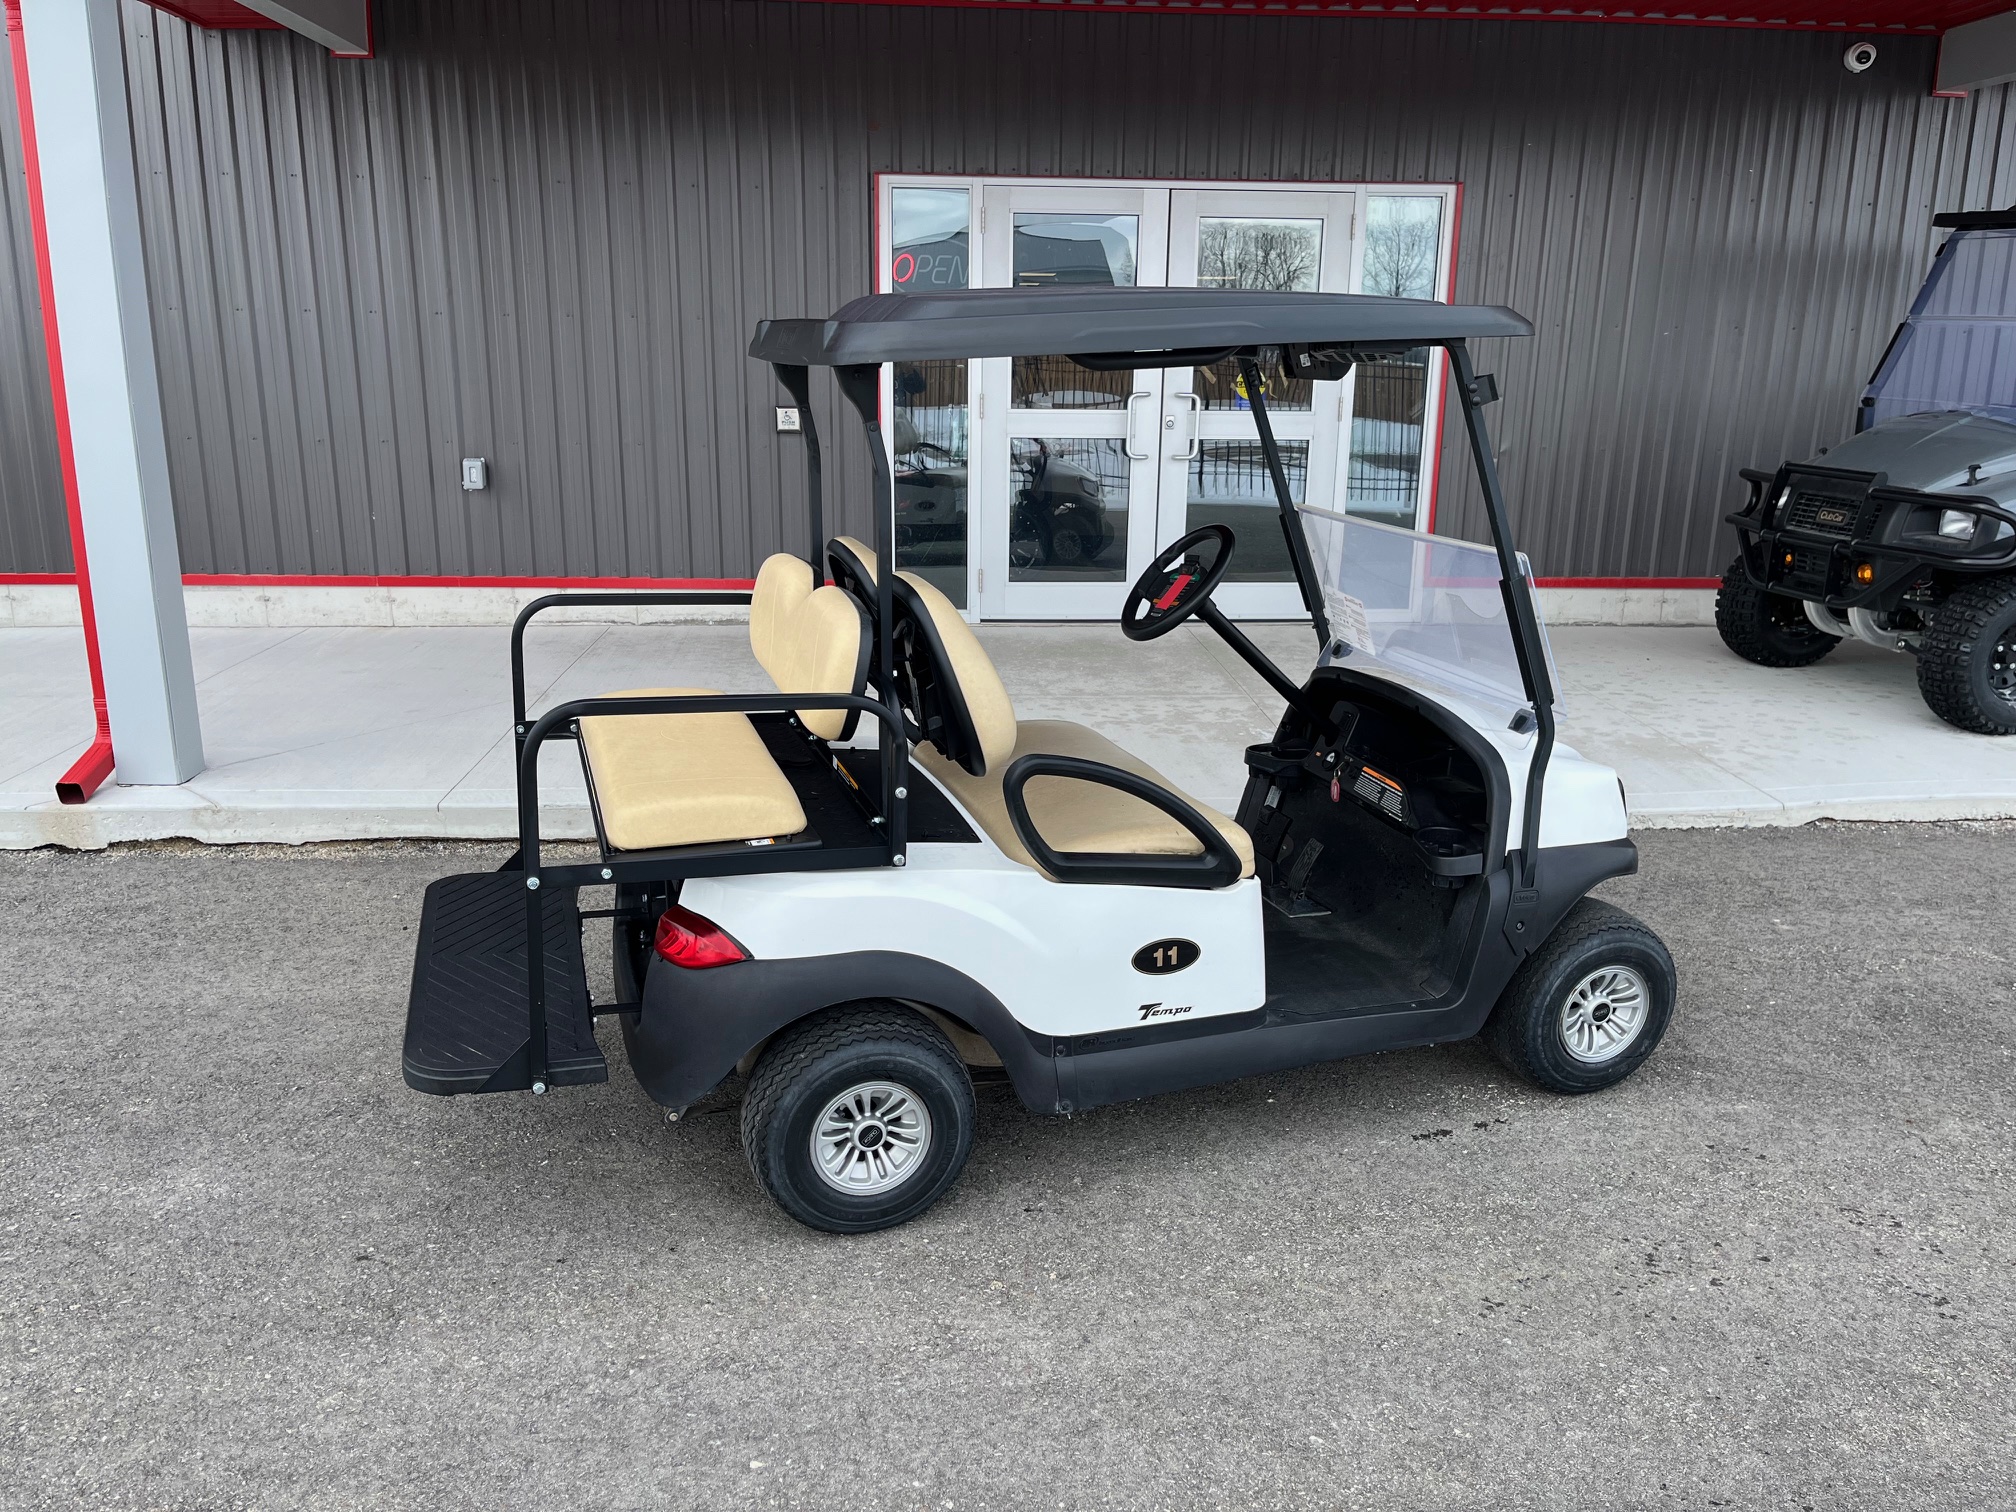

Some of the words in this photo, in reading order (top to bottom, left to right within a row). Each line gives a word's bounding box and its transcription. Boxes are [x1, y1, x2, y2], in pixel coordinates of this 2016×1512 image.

[893, 253, 969, 284] OPEN
[1153, 945, 1178, 967] 11
[1138, 1002, 1194, 1021] Tempo
